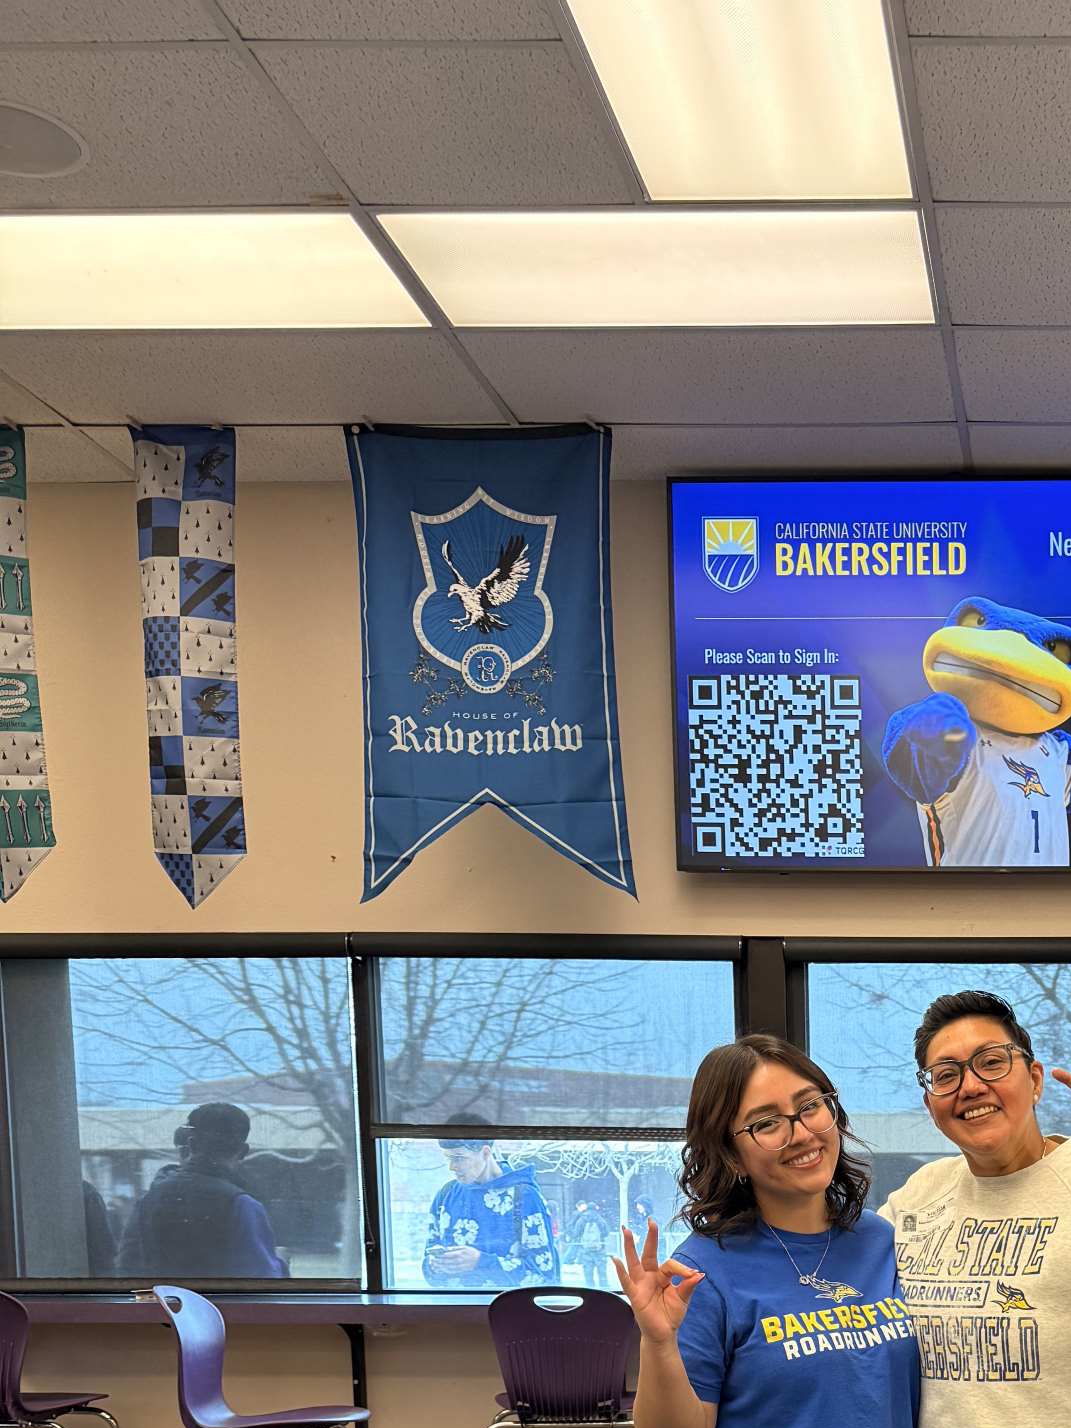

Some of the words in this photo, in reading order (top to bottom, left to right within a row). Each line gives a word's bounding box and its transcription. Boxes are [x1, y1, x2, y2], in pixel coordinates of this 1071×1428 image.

[775, 522, 849, 539] CALIFORNIA
[852, 522, 890, 539] STATE
[893, 522, 967, 539] UNIVERSITY
[775, 542, 967, 576] BAKERSFIELD
[704, 648, 743, 664] Please
[746, 648, 776, 664] Scan
[778, 649, 791, 664] to
[794, 648, 821, 667] Sign
[824, 648, 839, 664] In:
[452, 711, 497, 720] HOUSE
[503, 711, 519, 720] OF
[387, 714, 584, 756] Ravenclaw
[947, 1216, 1059, 1277] STATE
